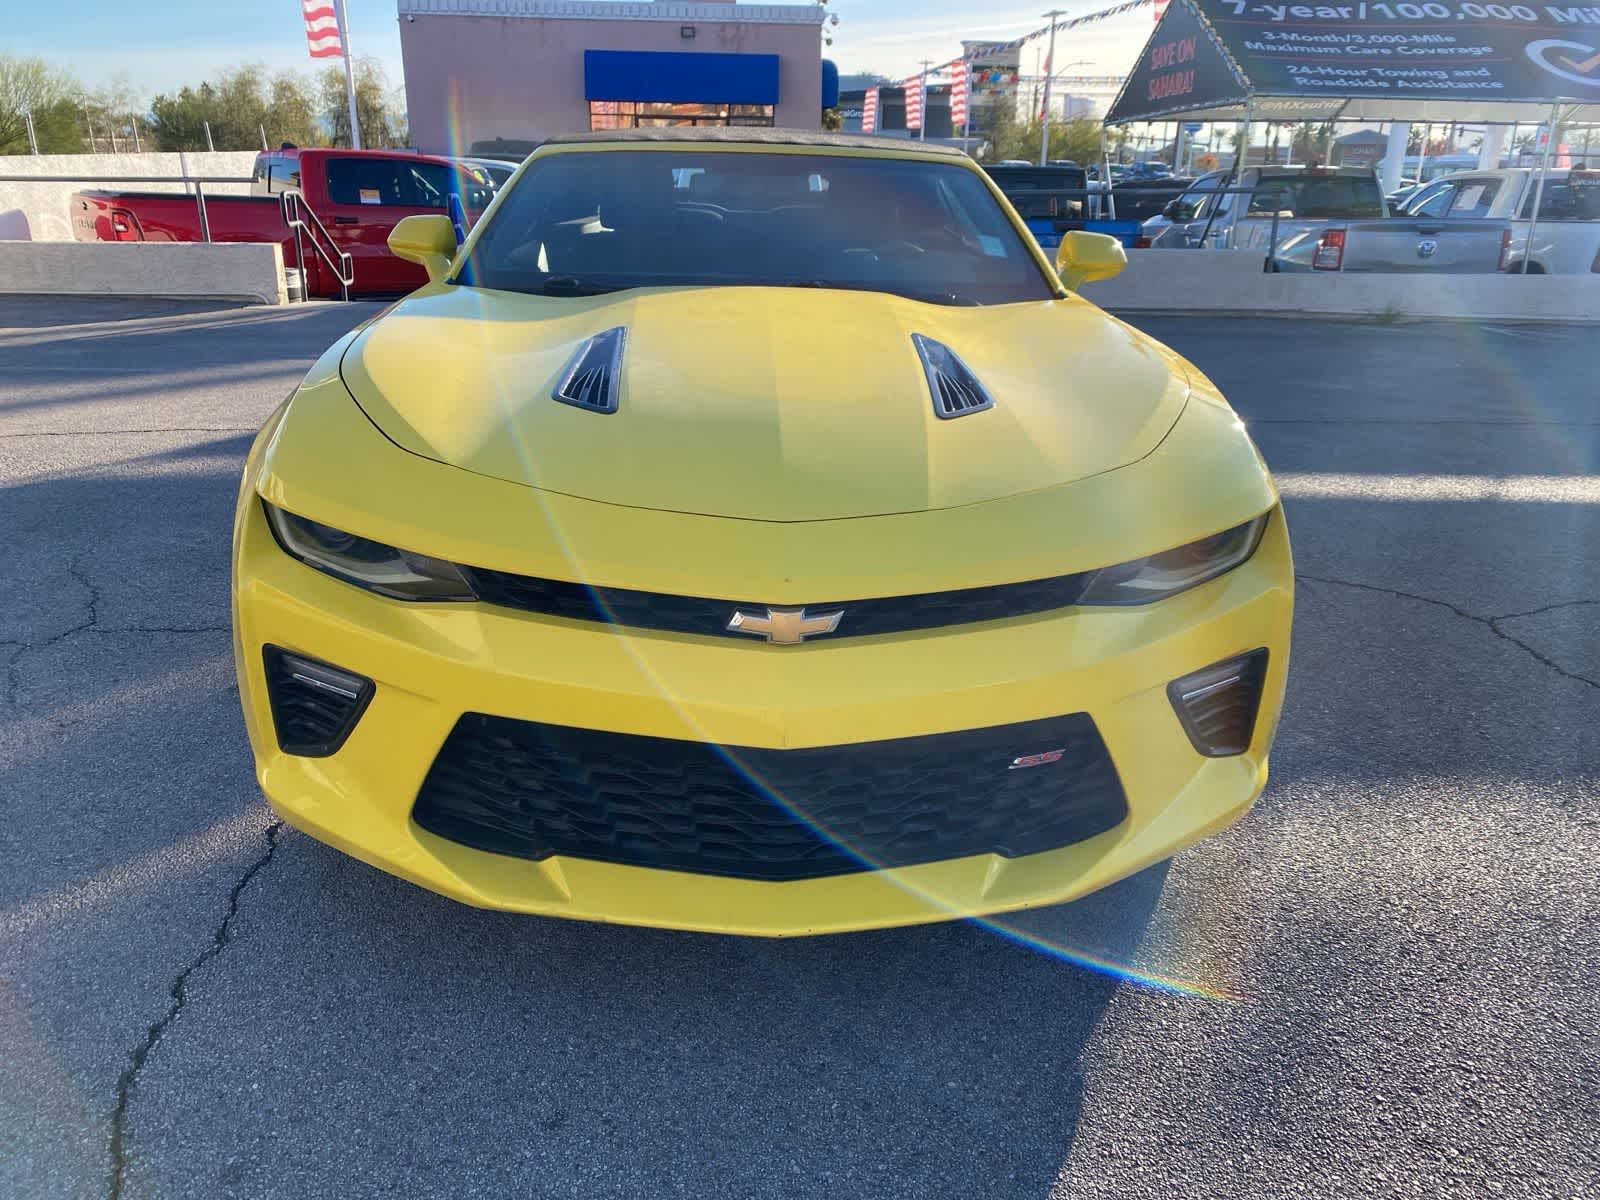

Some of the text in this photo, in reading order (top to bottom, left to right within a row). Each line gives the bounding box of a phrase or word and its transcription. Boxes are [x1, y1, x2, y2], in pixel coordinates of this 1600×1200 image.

[1262, 31, 1456, 44] 3-Month/3,000-Mile
[1244, 40, 1493, 55] Maximum Care Coverage
[1287, 65, 1491, 79] 24-Hour Towing and
[1294, 77, 1504, 89] Roadside Assistance
[1008, 748, 1067, 769] SS
